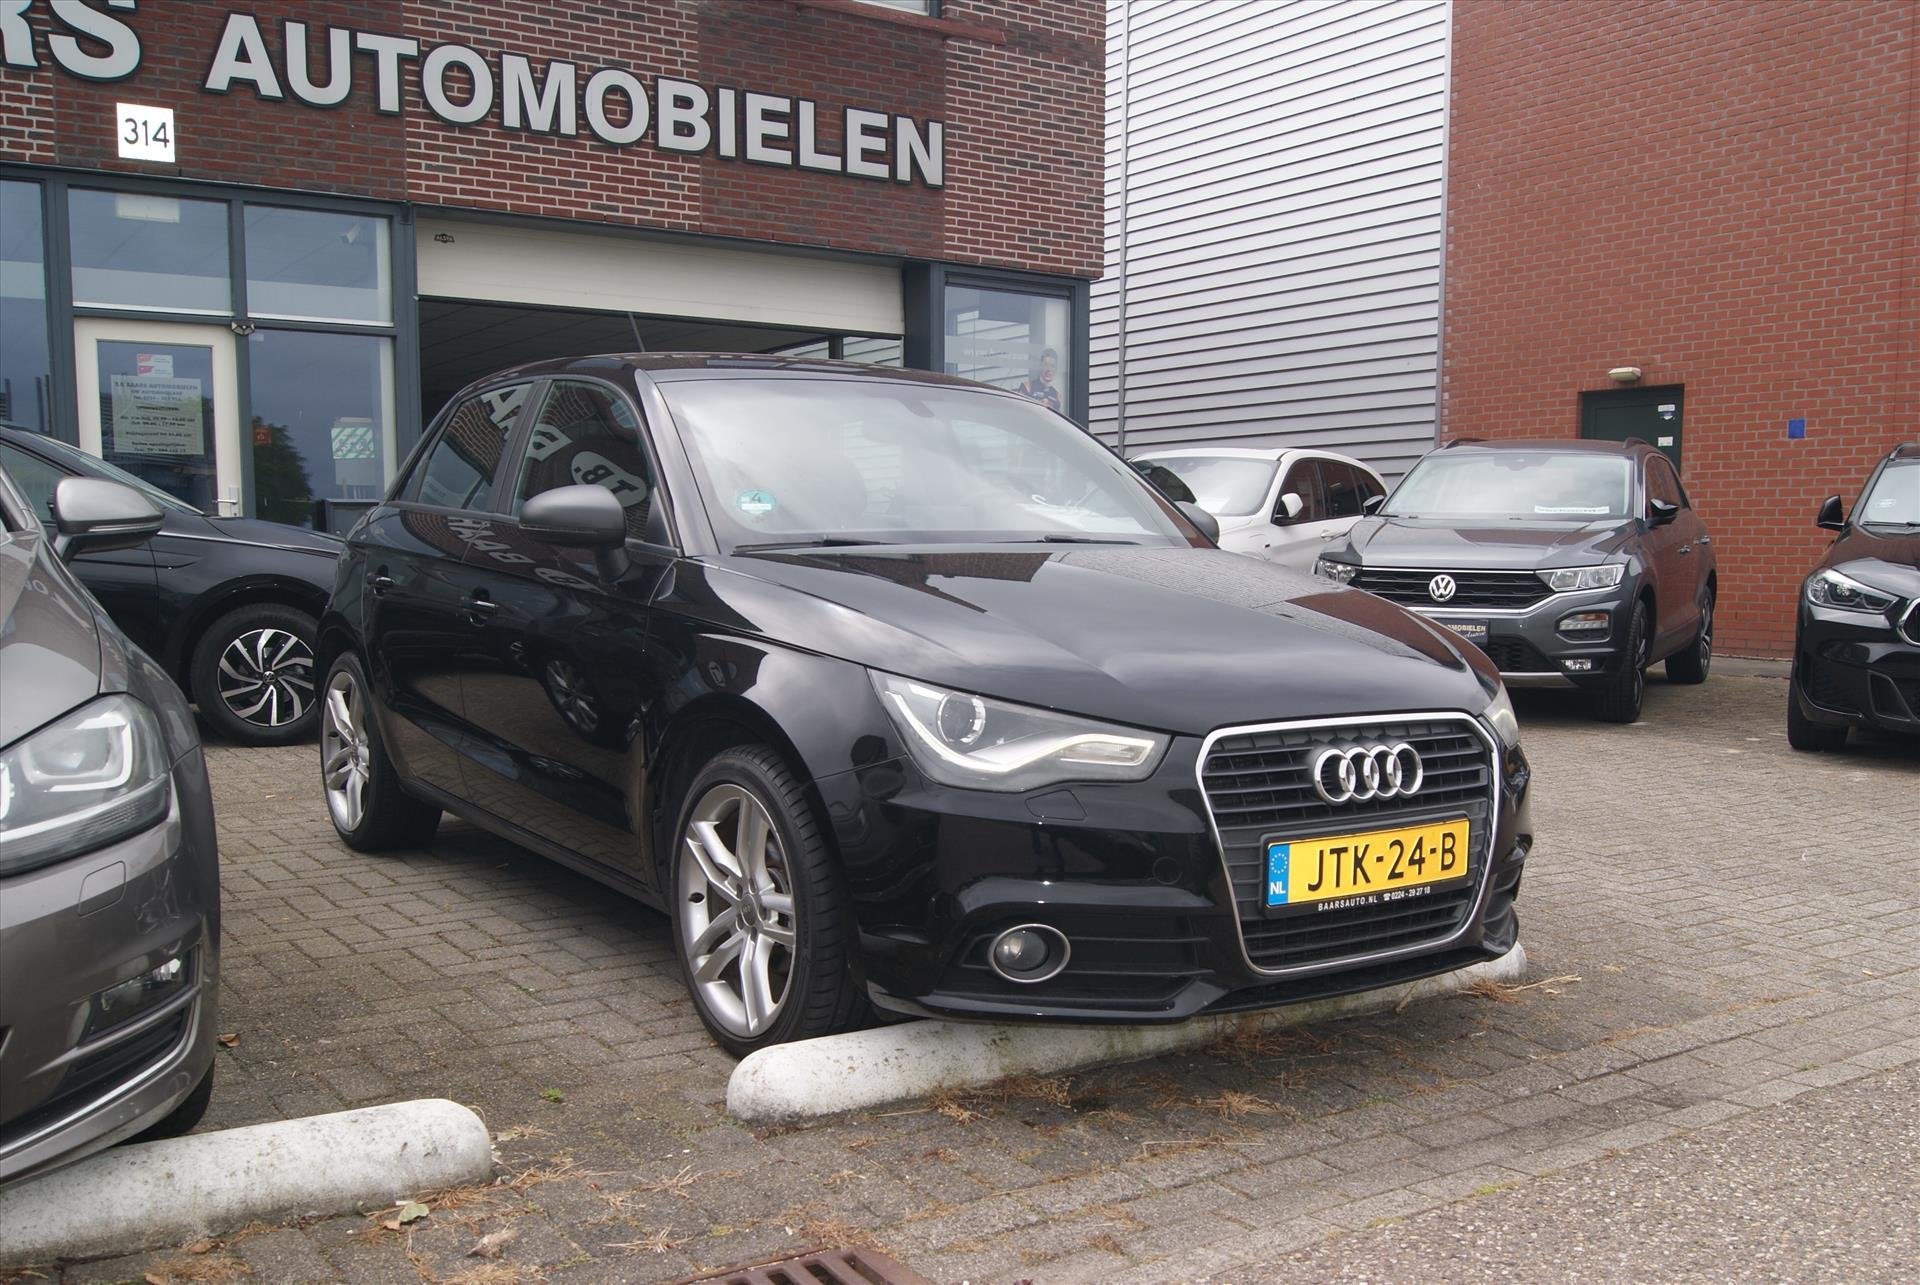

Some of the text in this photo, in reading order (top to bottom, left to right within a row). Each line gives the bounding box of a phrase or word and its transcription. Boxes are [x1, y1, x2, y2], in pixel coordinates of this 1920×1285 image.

[205, 13, 944, 187] AUTOMOBIELEN
[124, 118, 170, 148] 314
[1307, 831, 1456, 892] JTK-24-B
[1269, 880, 1286, 896] NL
[1318, 895, 1378, 911] BAARSAUTO.NL
